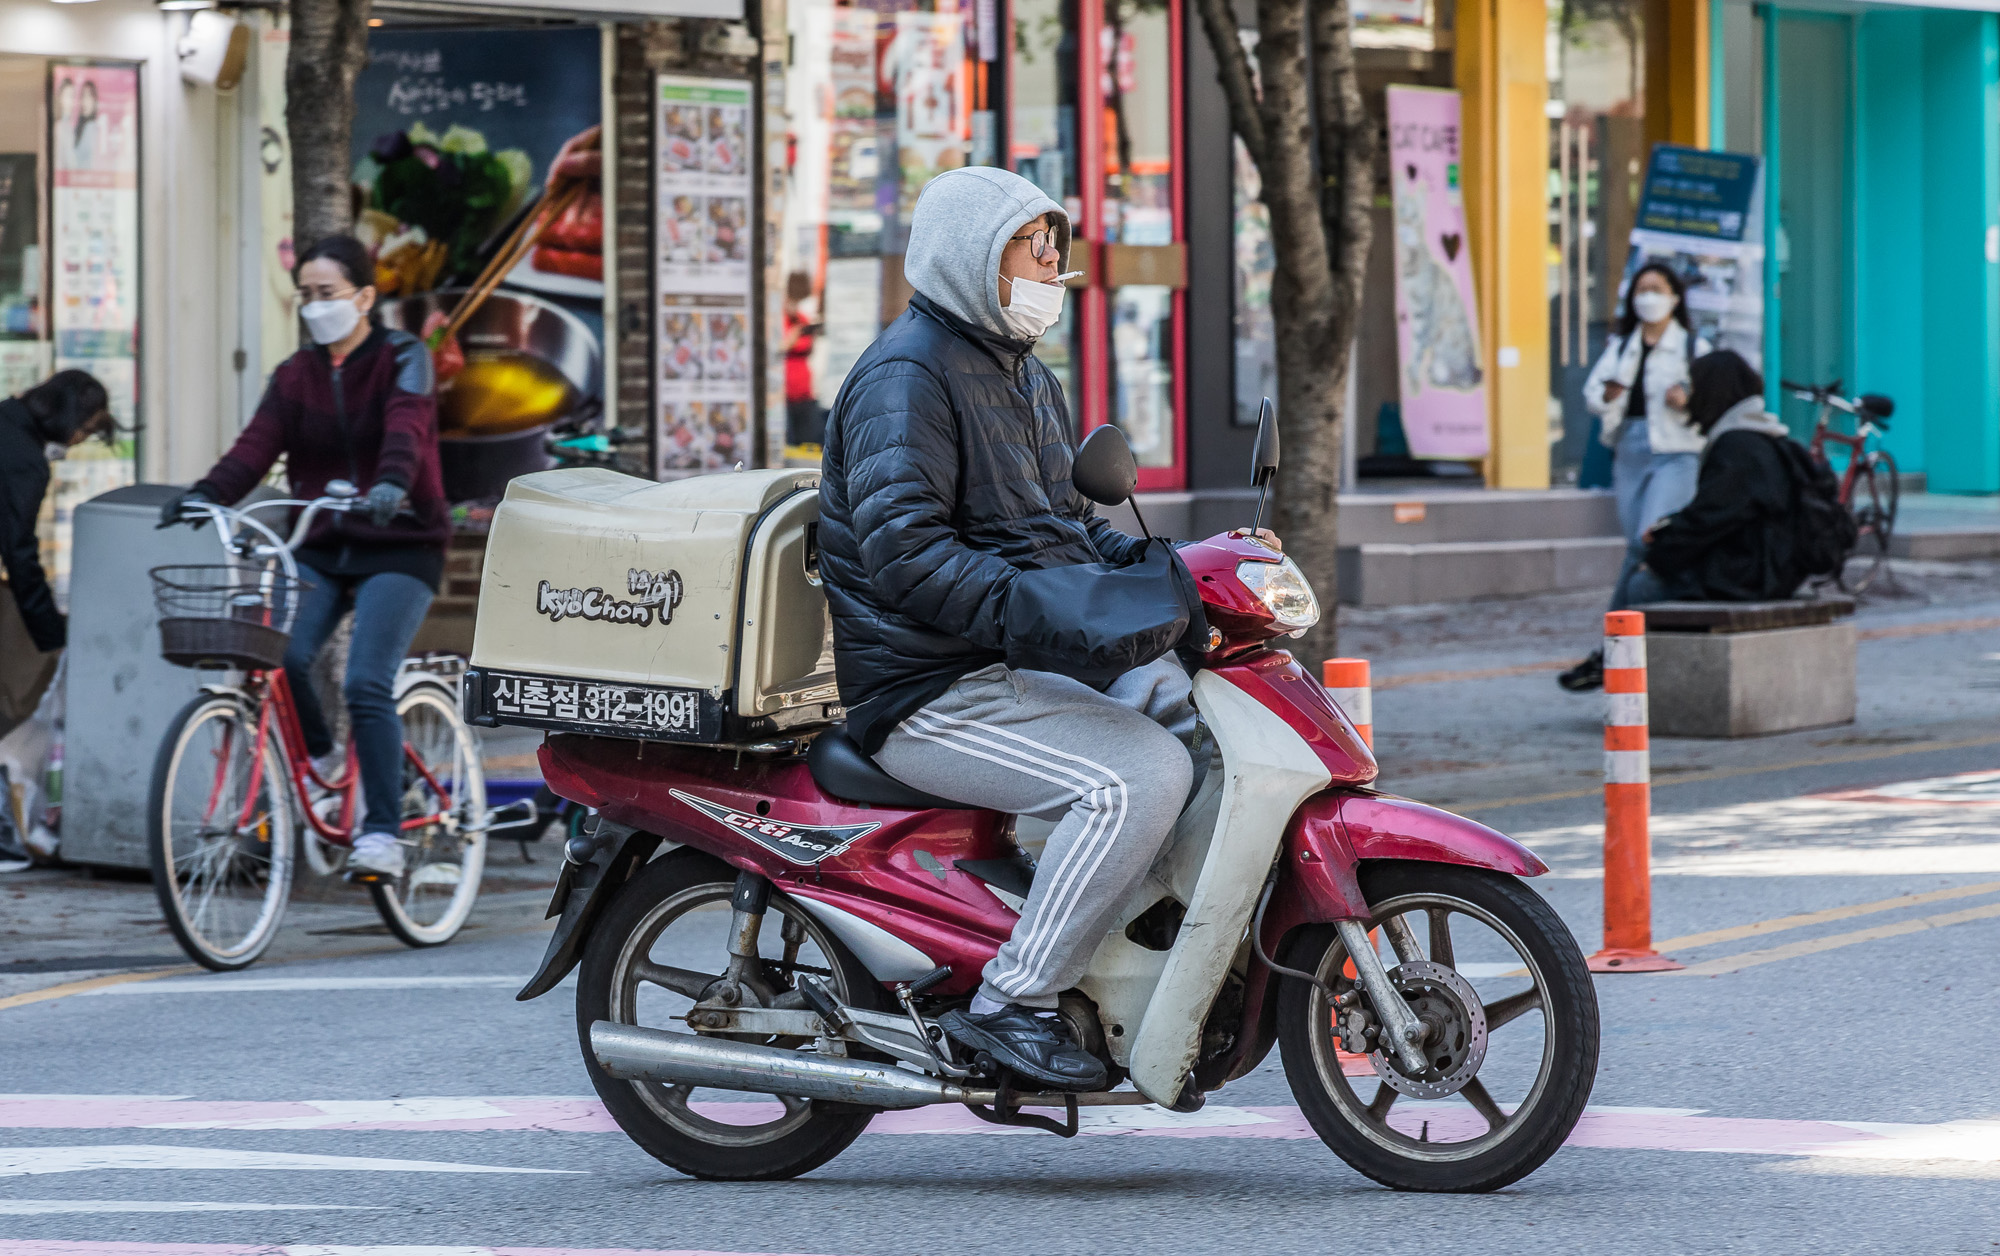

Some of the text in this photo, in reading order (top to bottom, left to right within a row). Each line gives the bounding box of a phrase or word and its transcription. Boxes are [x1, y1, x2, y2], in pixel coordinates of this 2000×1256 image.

[493, 678, 695, 728] 신촌점 312-1991
[779, 834, 827, 852] Ace
